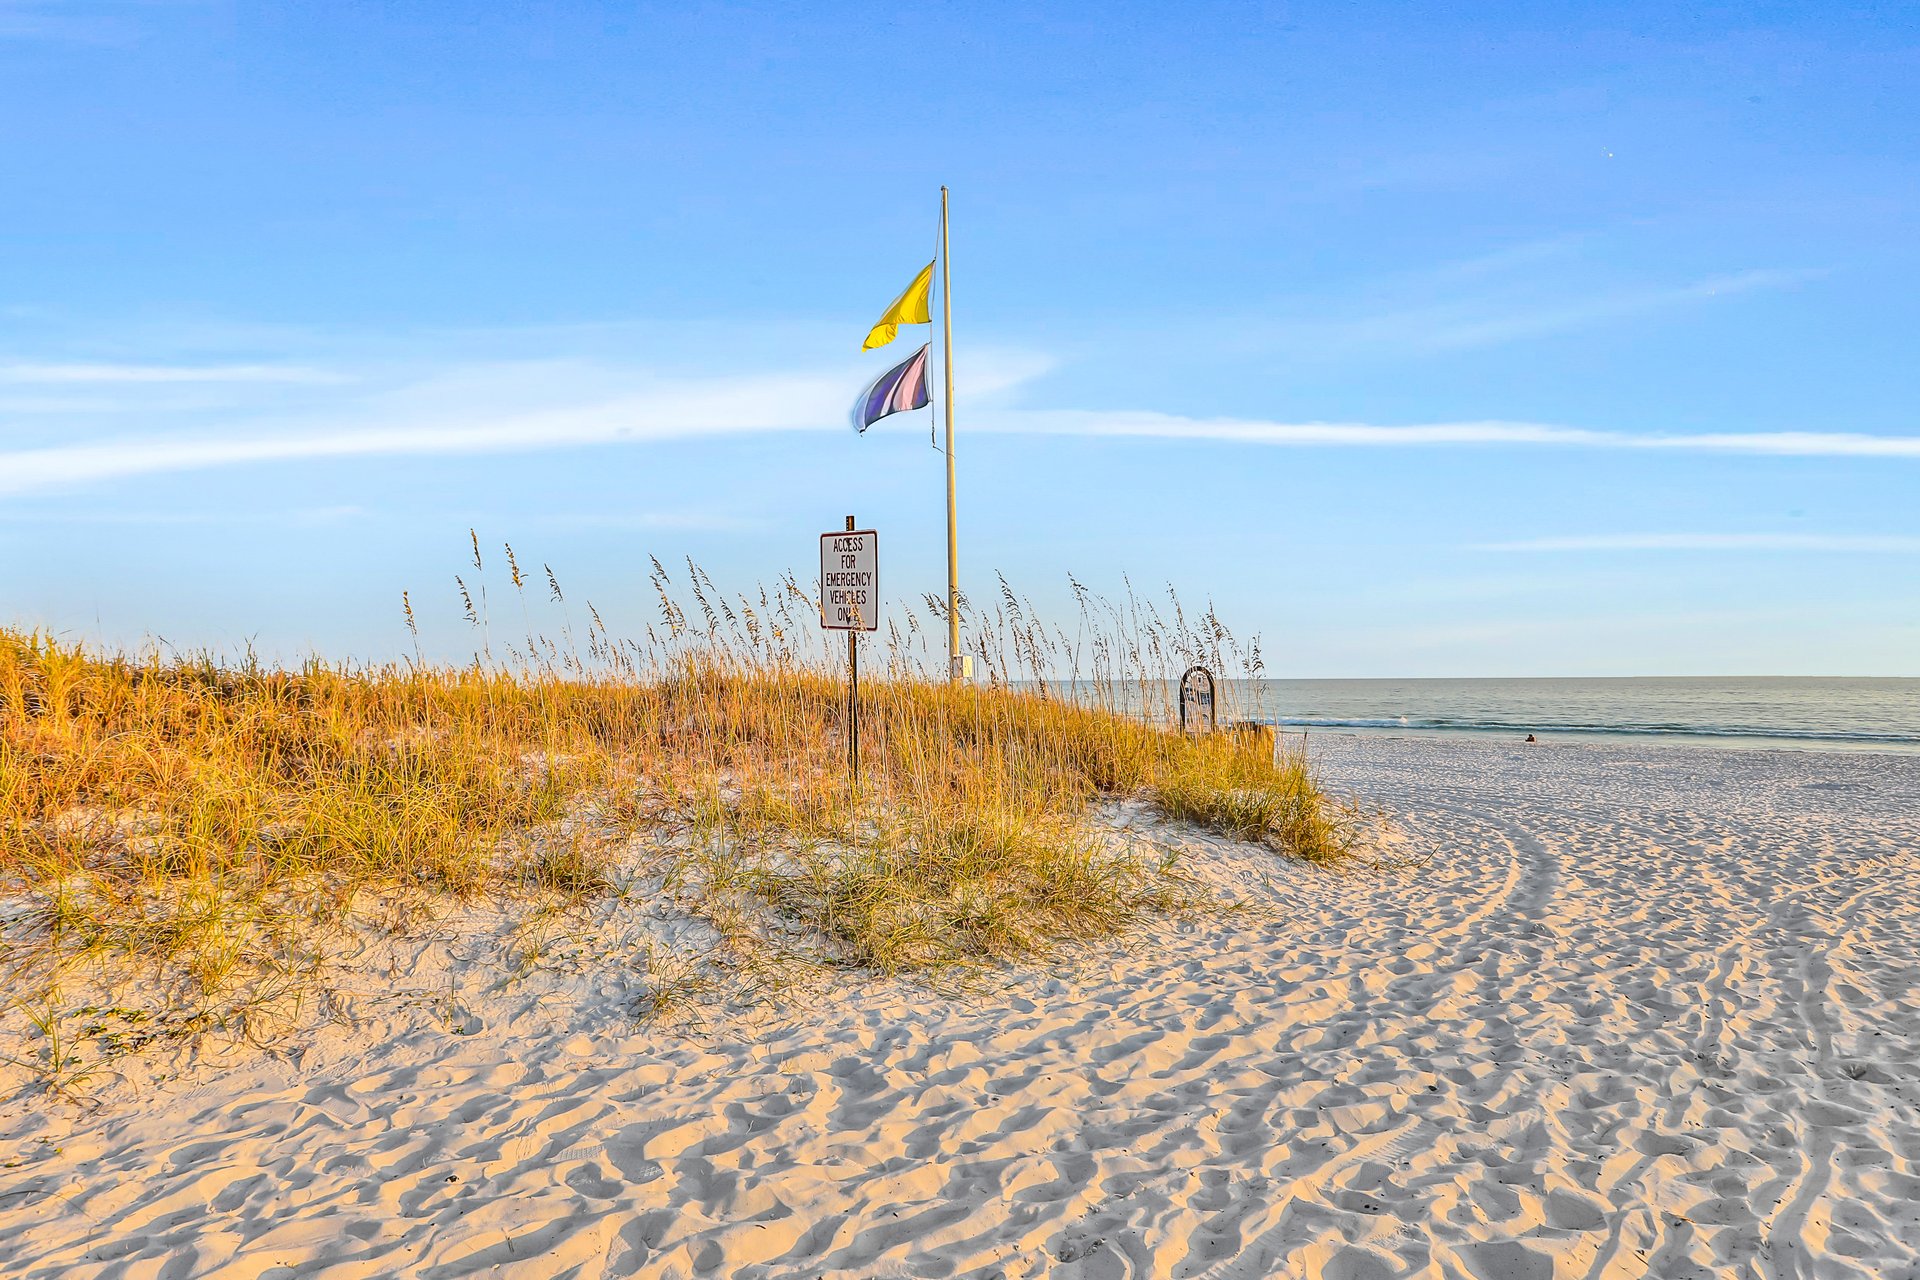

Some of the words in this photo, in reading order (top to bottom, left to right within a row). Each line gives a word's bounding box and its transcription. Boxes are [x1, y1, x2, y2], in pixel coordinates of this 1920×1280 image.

[833, 537, 863, 552] ACCESS
[841, 554, 856, 569] FOR
[826, 572, 872, 587] EMERGENCY
[837, 607, 859, 621] ON
